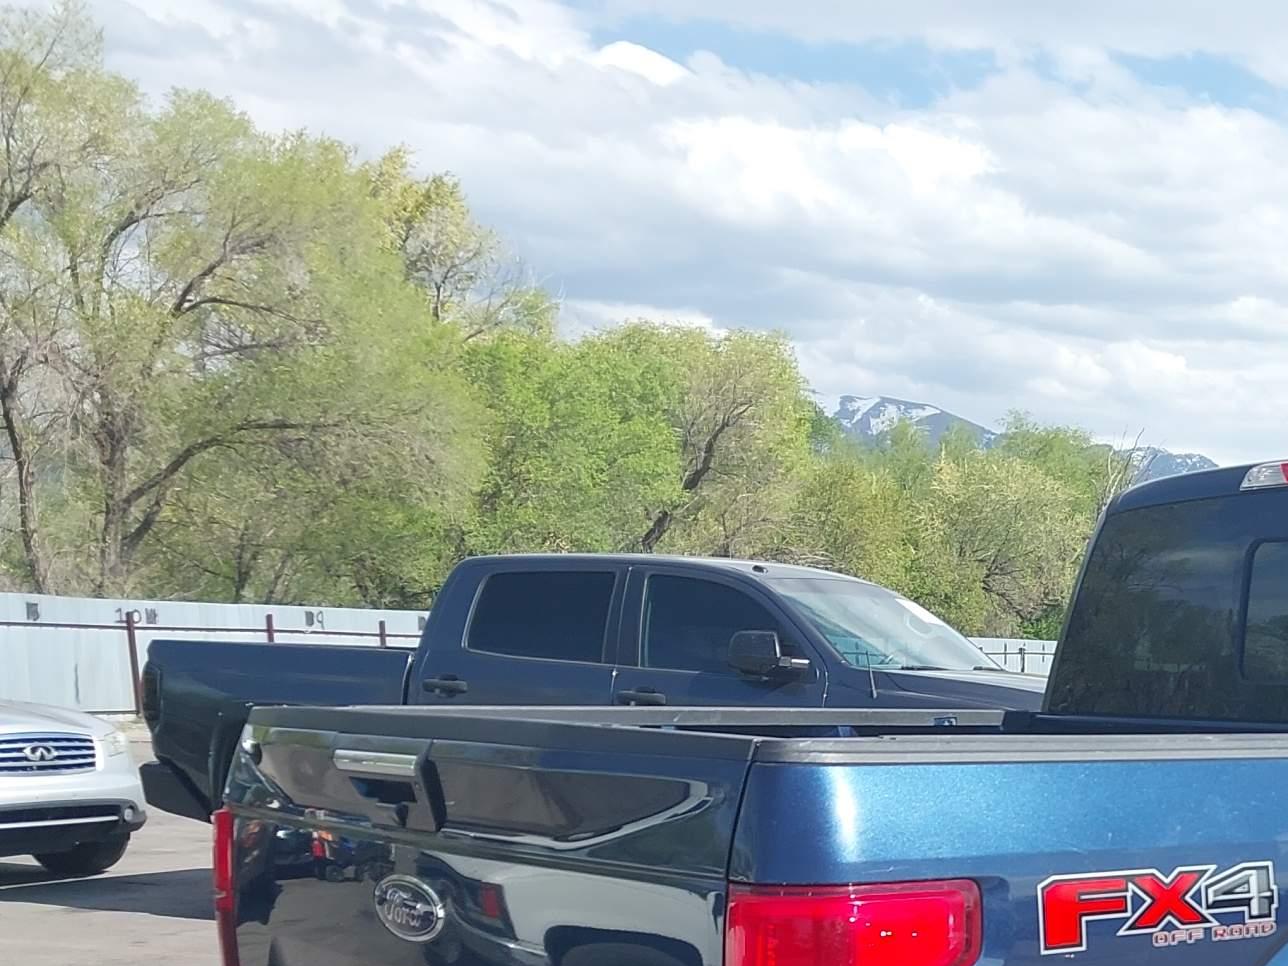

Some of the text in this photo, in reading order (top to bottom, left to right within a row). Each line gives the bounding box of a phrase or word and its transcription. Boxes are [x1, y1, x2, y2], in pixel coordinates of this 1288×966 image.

[1037, 861, 1278, 955] FX4
[1152, 921, 1277, 947] OFF ROAD
